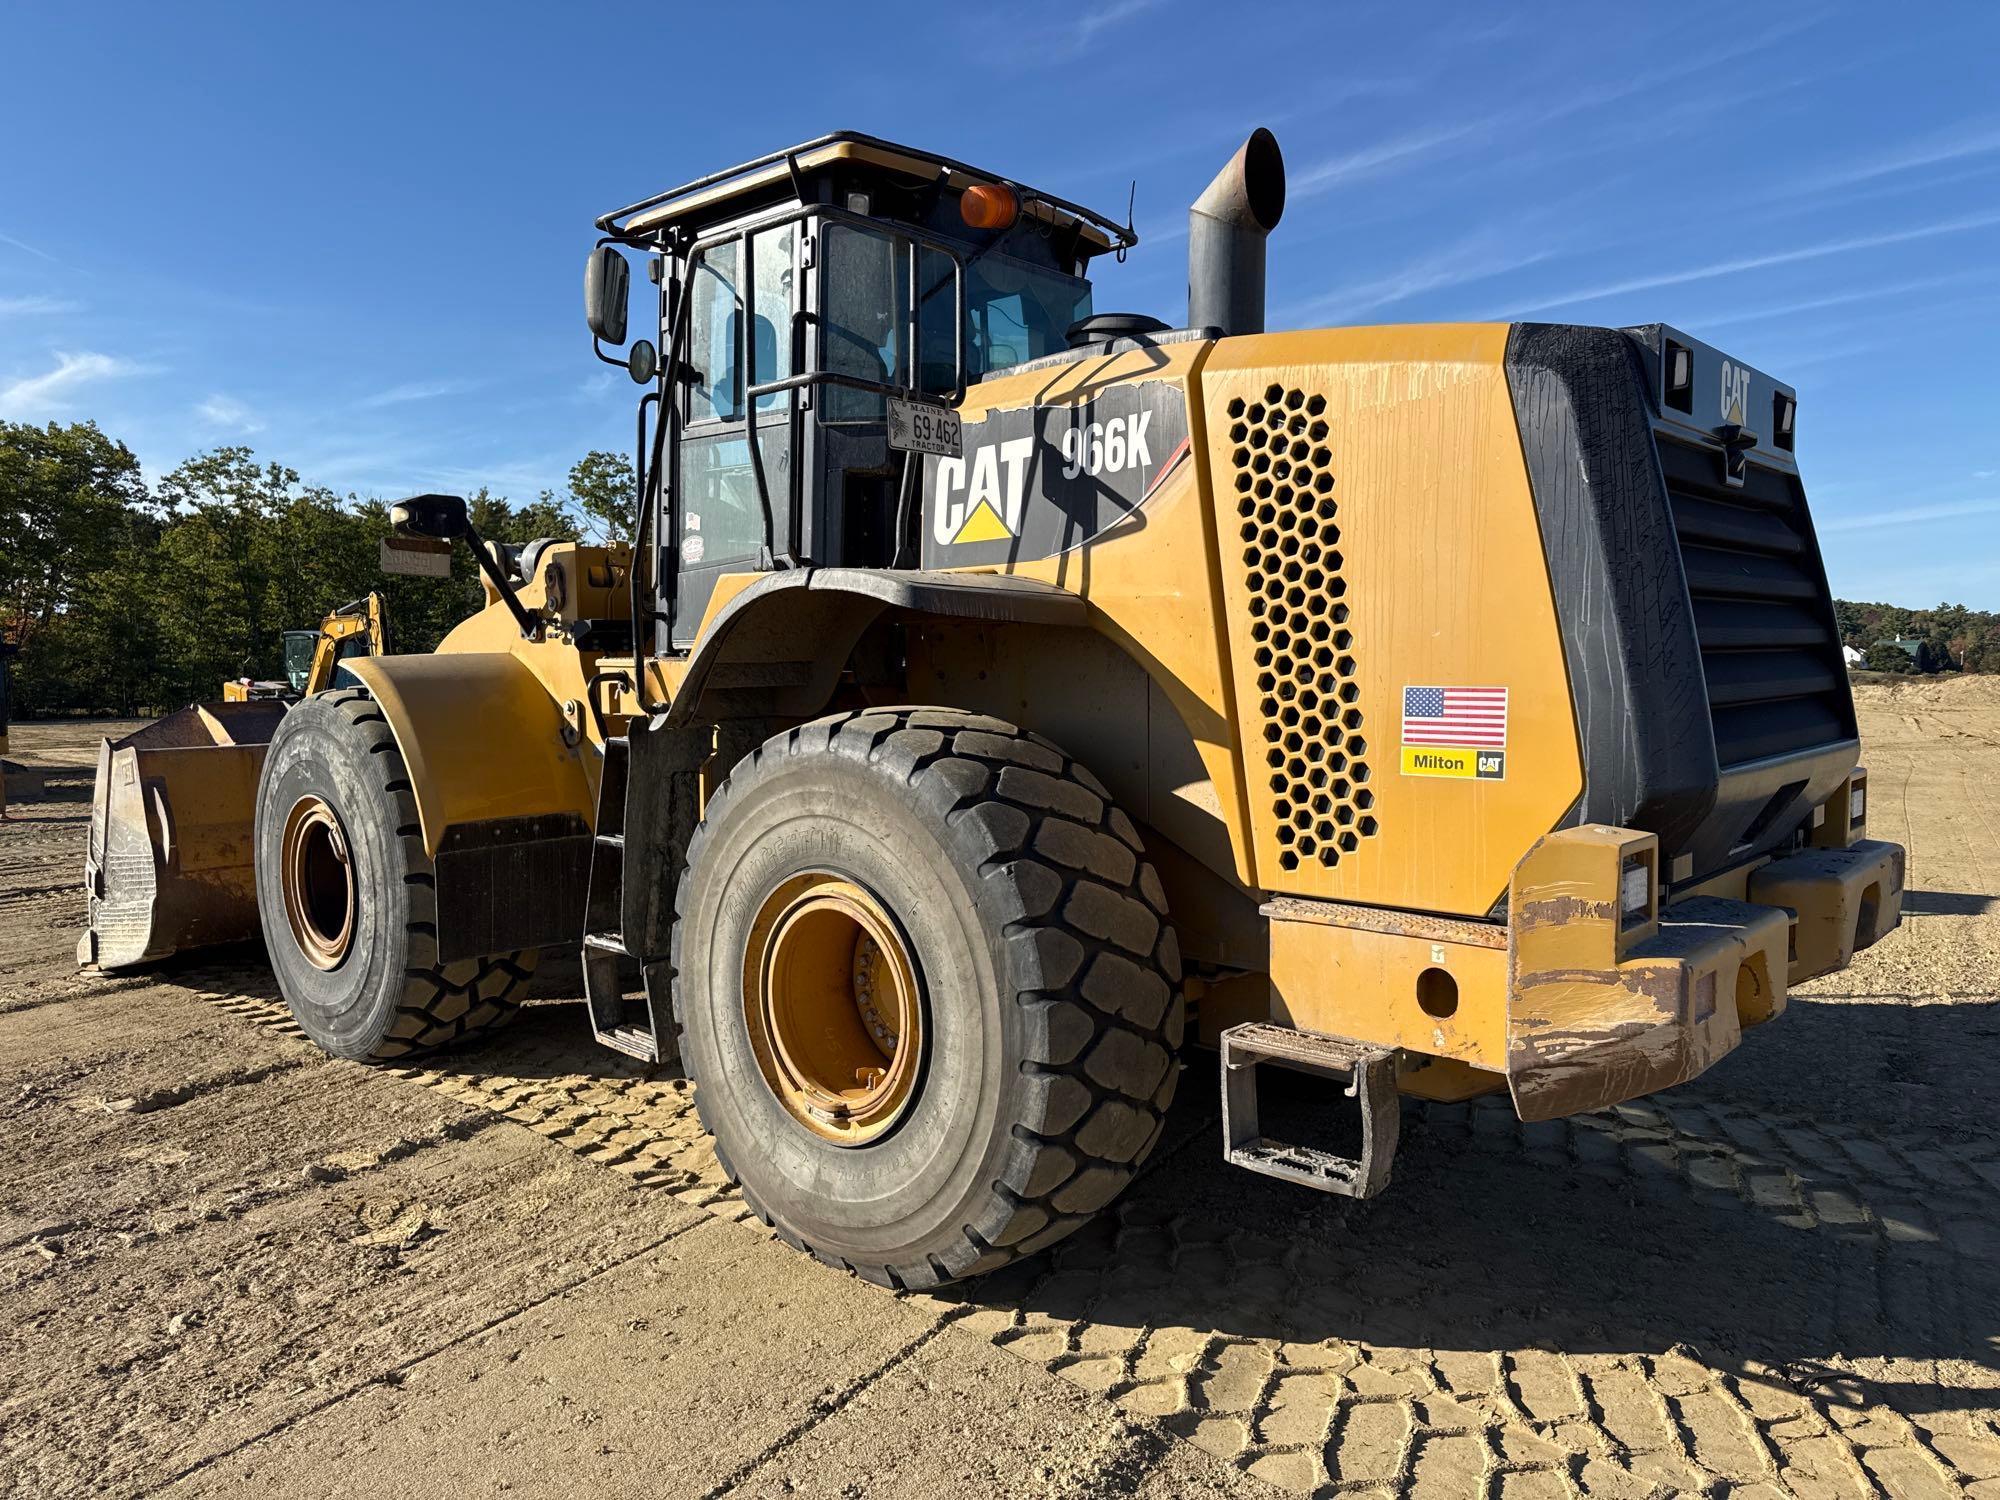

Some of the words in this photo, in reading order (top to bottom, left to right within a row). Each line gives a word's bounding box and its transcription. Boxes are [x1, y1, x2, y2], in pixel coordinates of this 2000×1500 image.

[910, 404, 943, 416] MAINE
[1721, 360, 1750, 427] CAT
[911, 440, 945, 451] TRACTOR
[1062, 410, 1152, 480] 966K
[933, 436, 1033, 545] CAT
[1414, 755, 1464, 770] Milton
[1478, 757, 1502, 772] CAT
